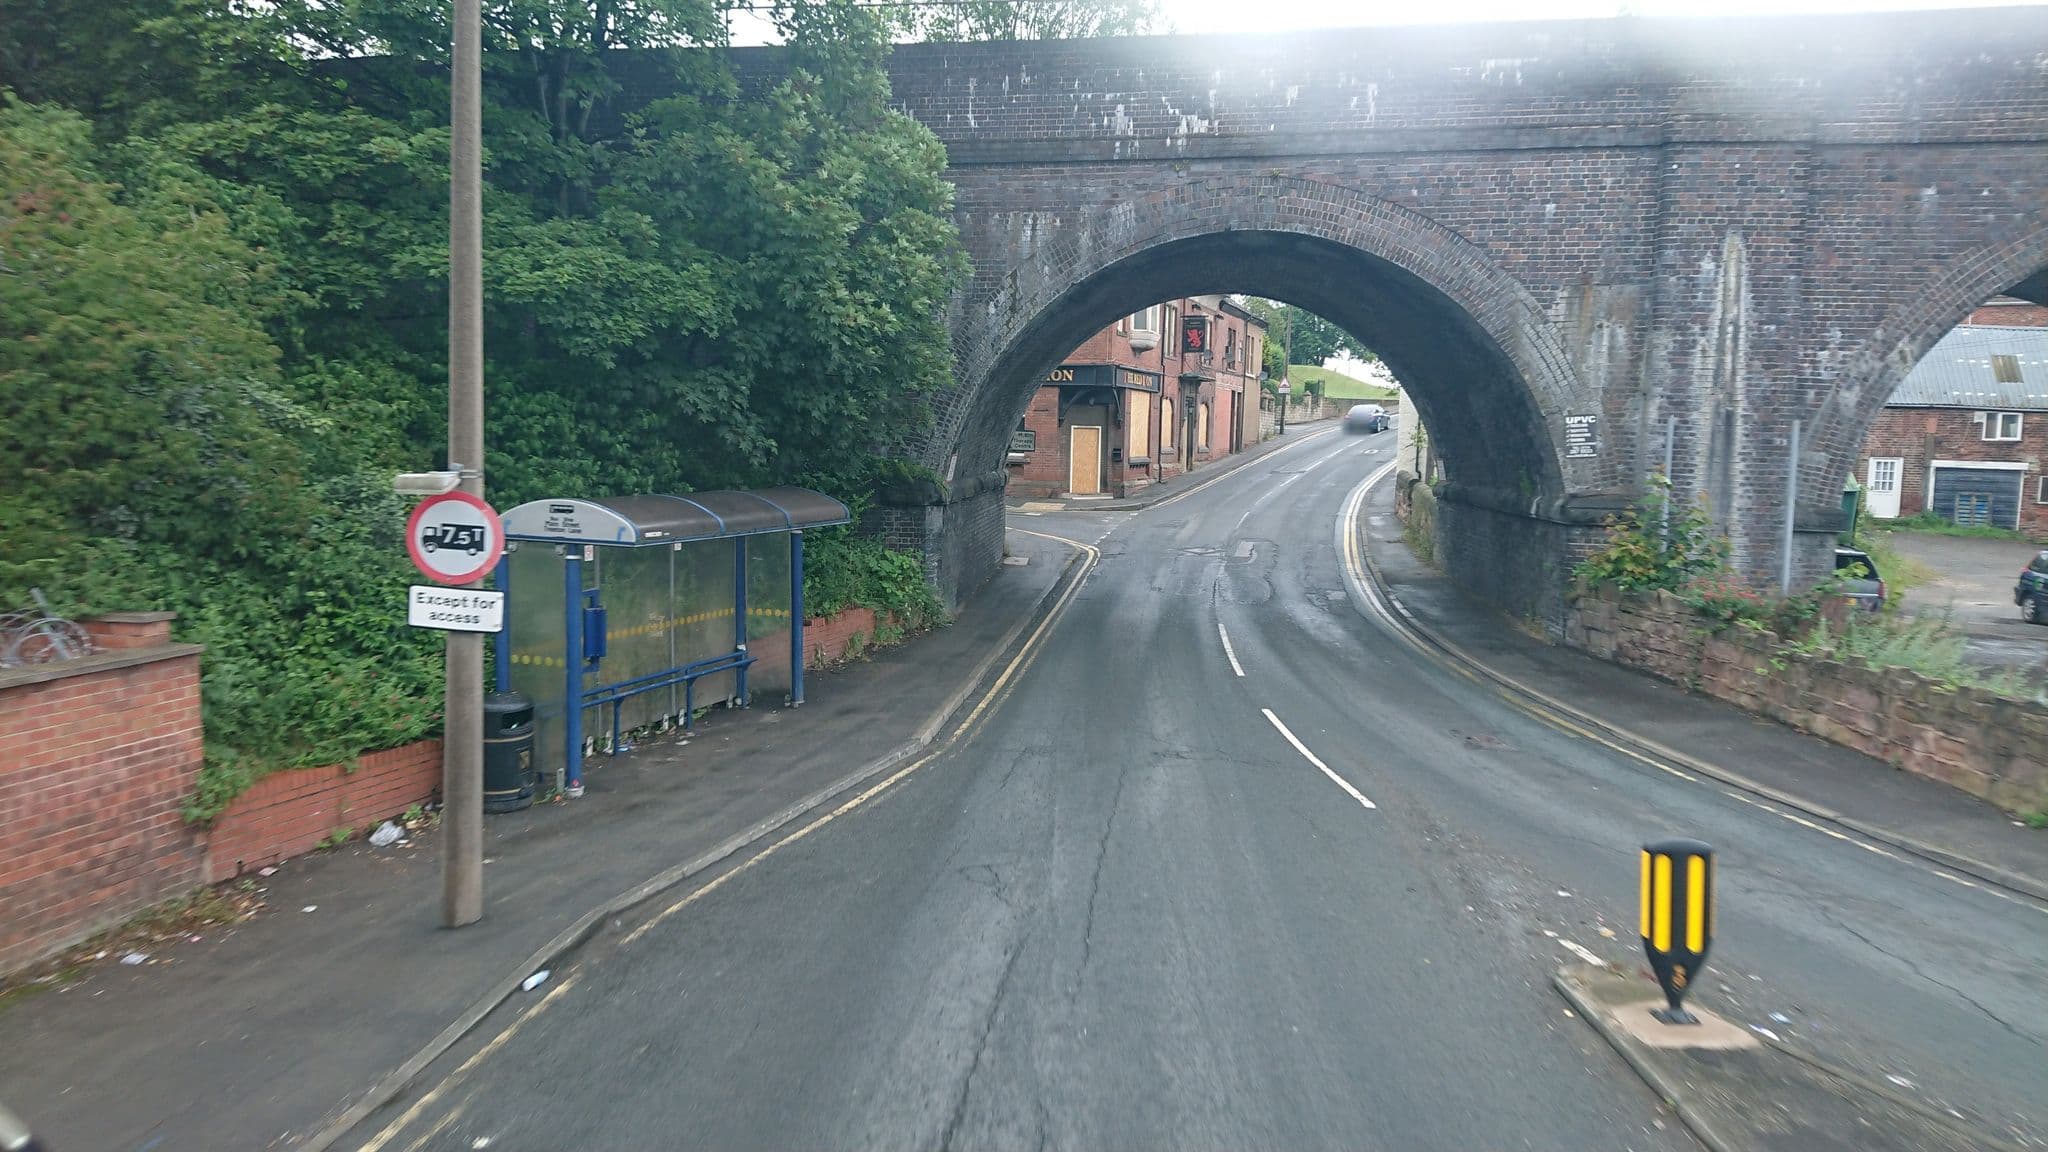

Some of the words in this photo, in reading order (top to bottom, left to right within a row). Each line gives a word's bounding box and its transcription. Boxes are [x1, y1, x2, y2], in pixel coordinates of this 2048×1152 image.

[1565, 415, 1596, 424] UPVC
[416, 592, 469, 609] Except
[472, 596, 496, 609] for
[429, 611, 480, 624] access
